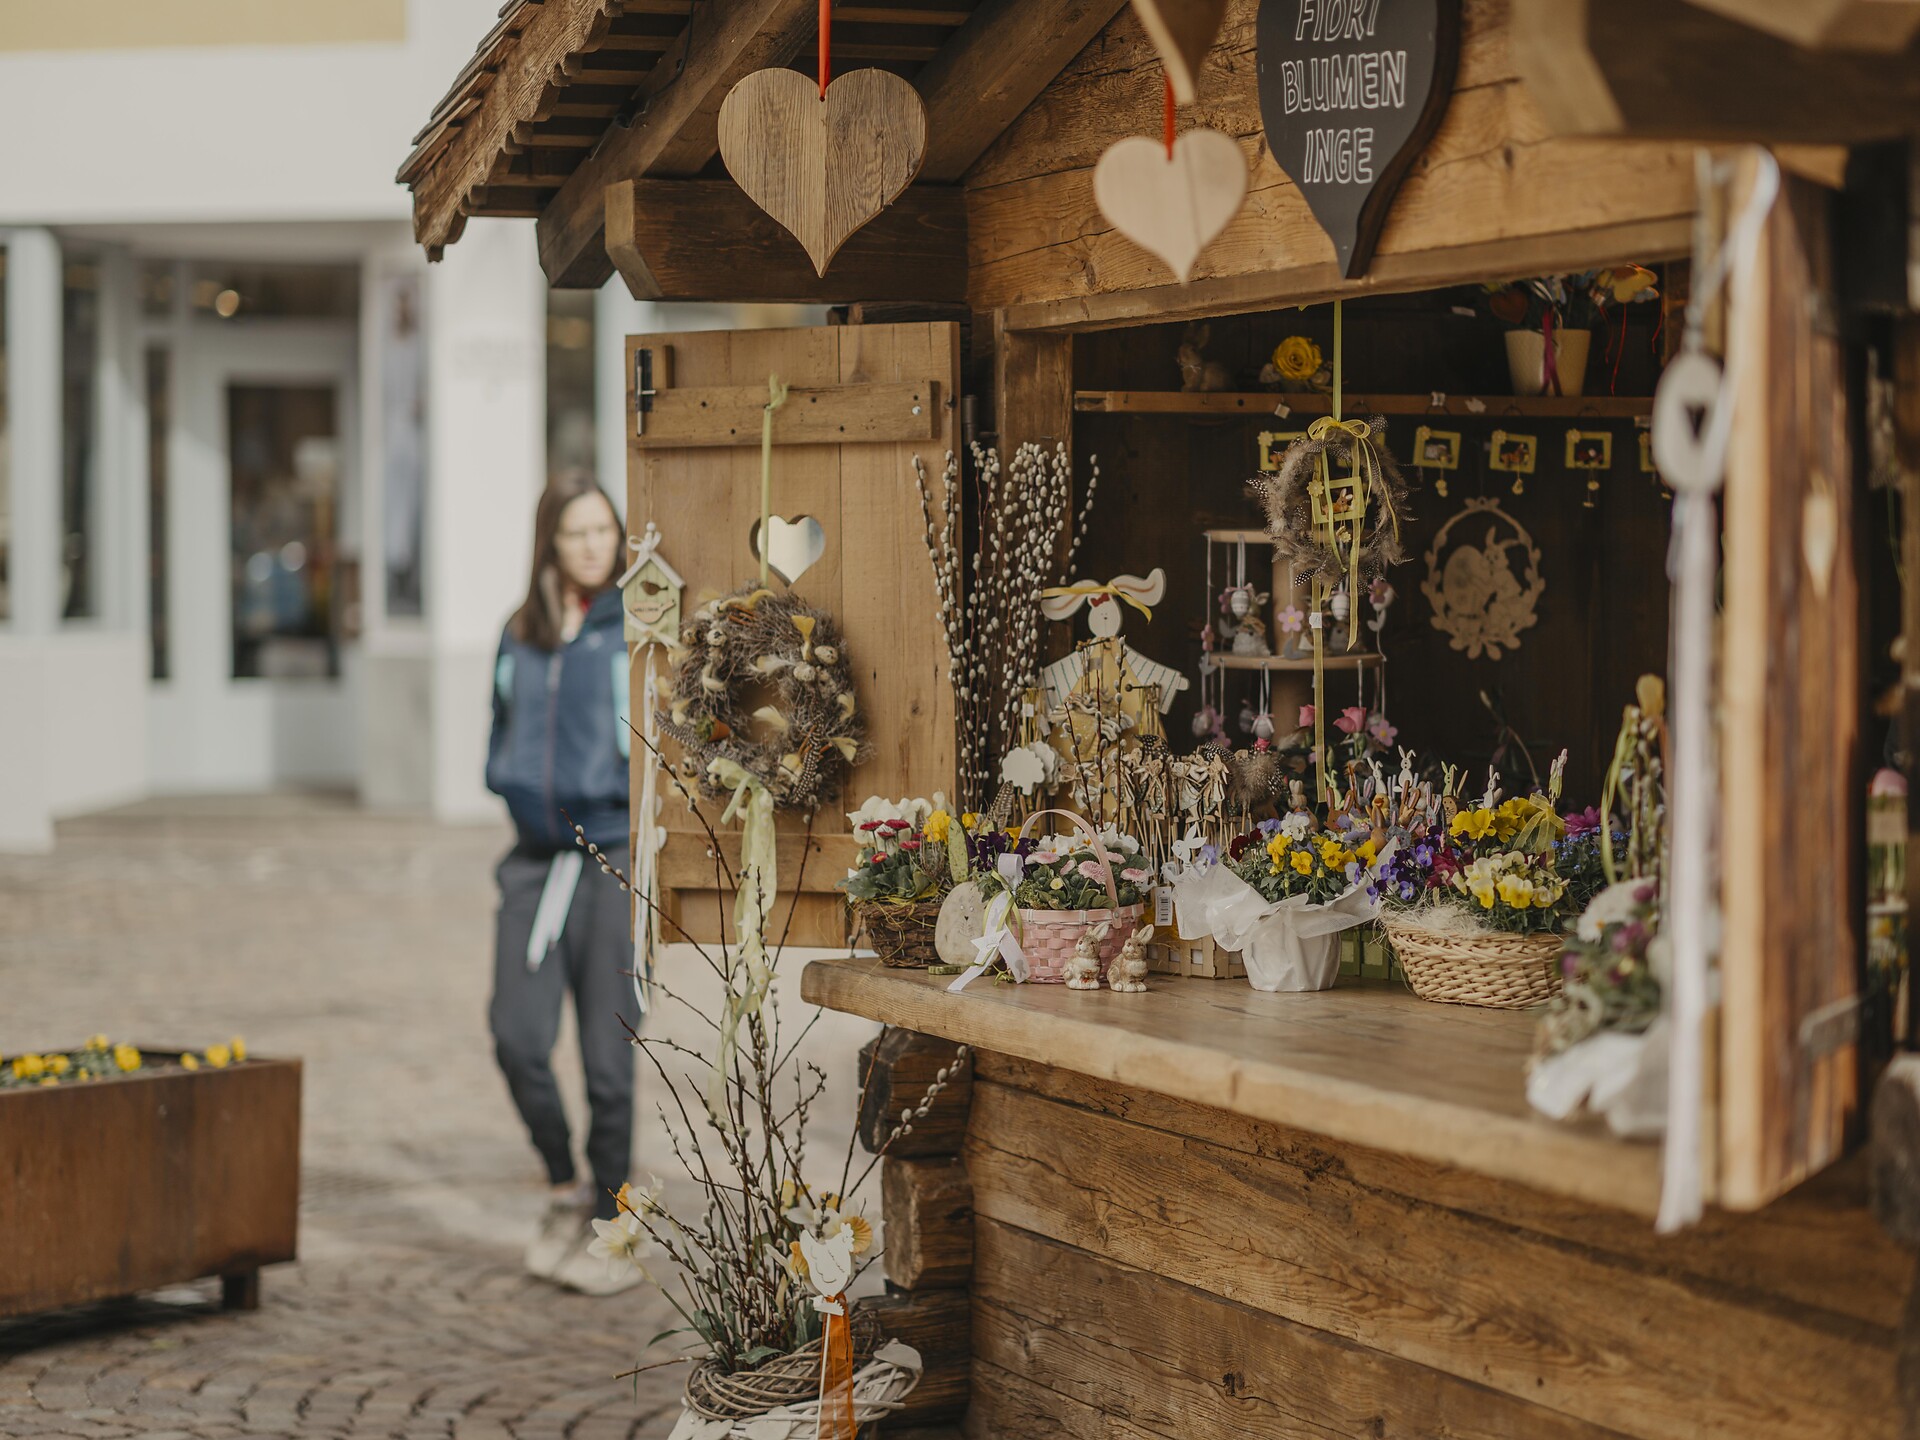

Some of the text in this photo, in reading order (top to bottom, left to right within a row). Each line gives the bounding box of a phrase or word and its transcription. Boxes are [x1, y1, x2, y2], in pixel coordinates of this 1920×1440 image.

[1295, 0, 1380, 41] FIORI
[1281, 51, 1406, 114] BLUMEN
[1303, 127, 1374, 184] INGE
